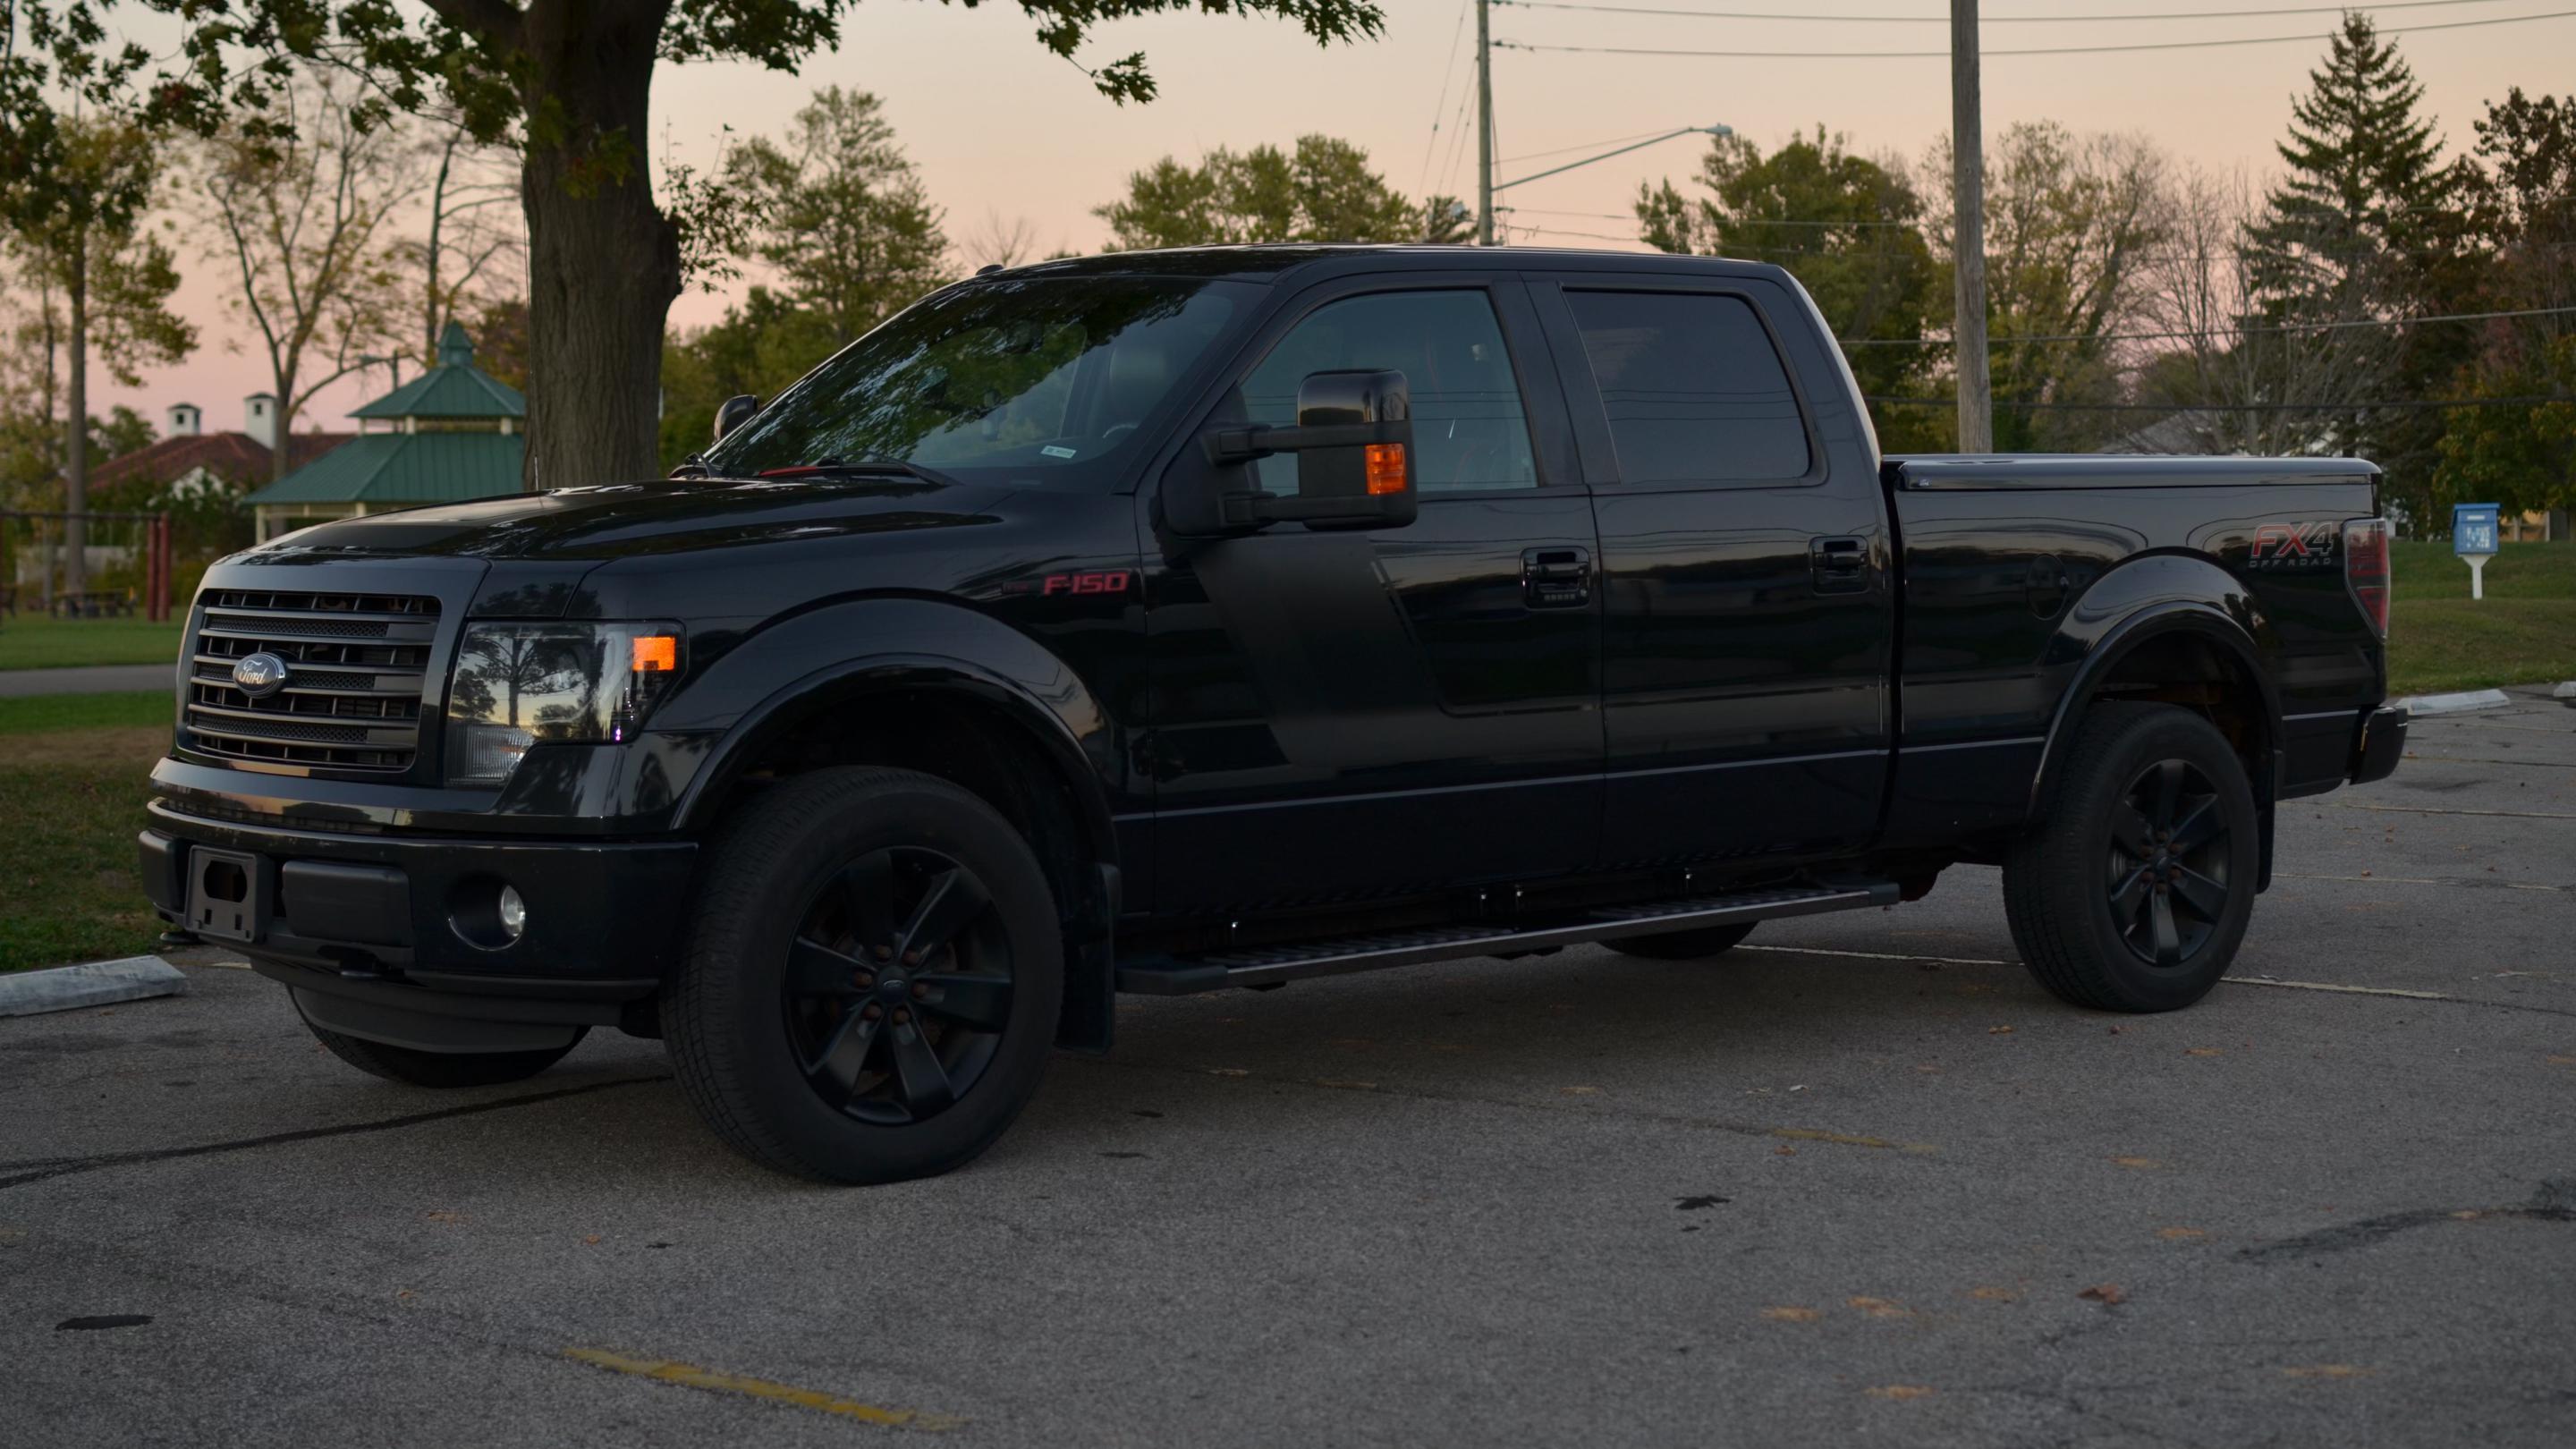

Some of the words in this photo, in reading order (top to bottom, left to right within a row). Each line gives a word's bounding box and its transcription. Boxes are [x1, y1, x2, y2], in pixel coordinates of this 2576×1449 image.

[2251, 521, 2334, 558] FX4
[2248, 558, 2282, 569] OFF
[2287, 557, 2332, 567] ROAD
[238, 658, 269, 685] Ford
